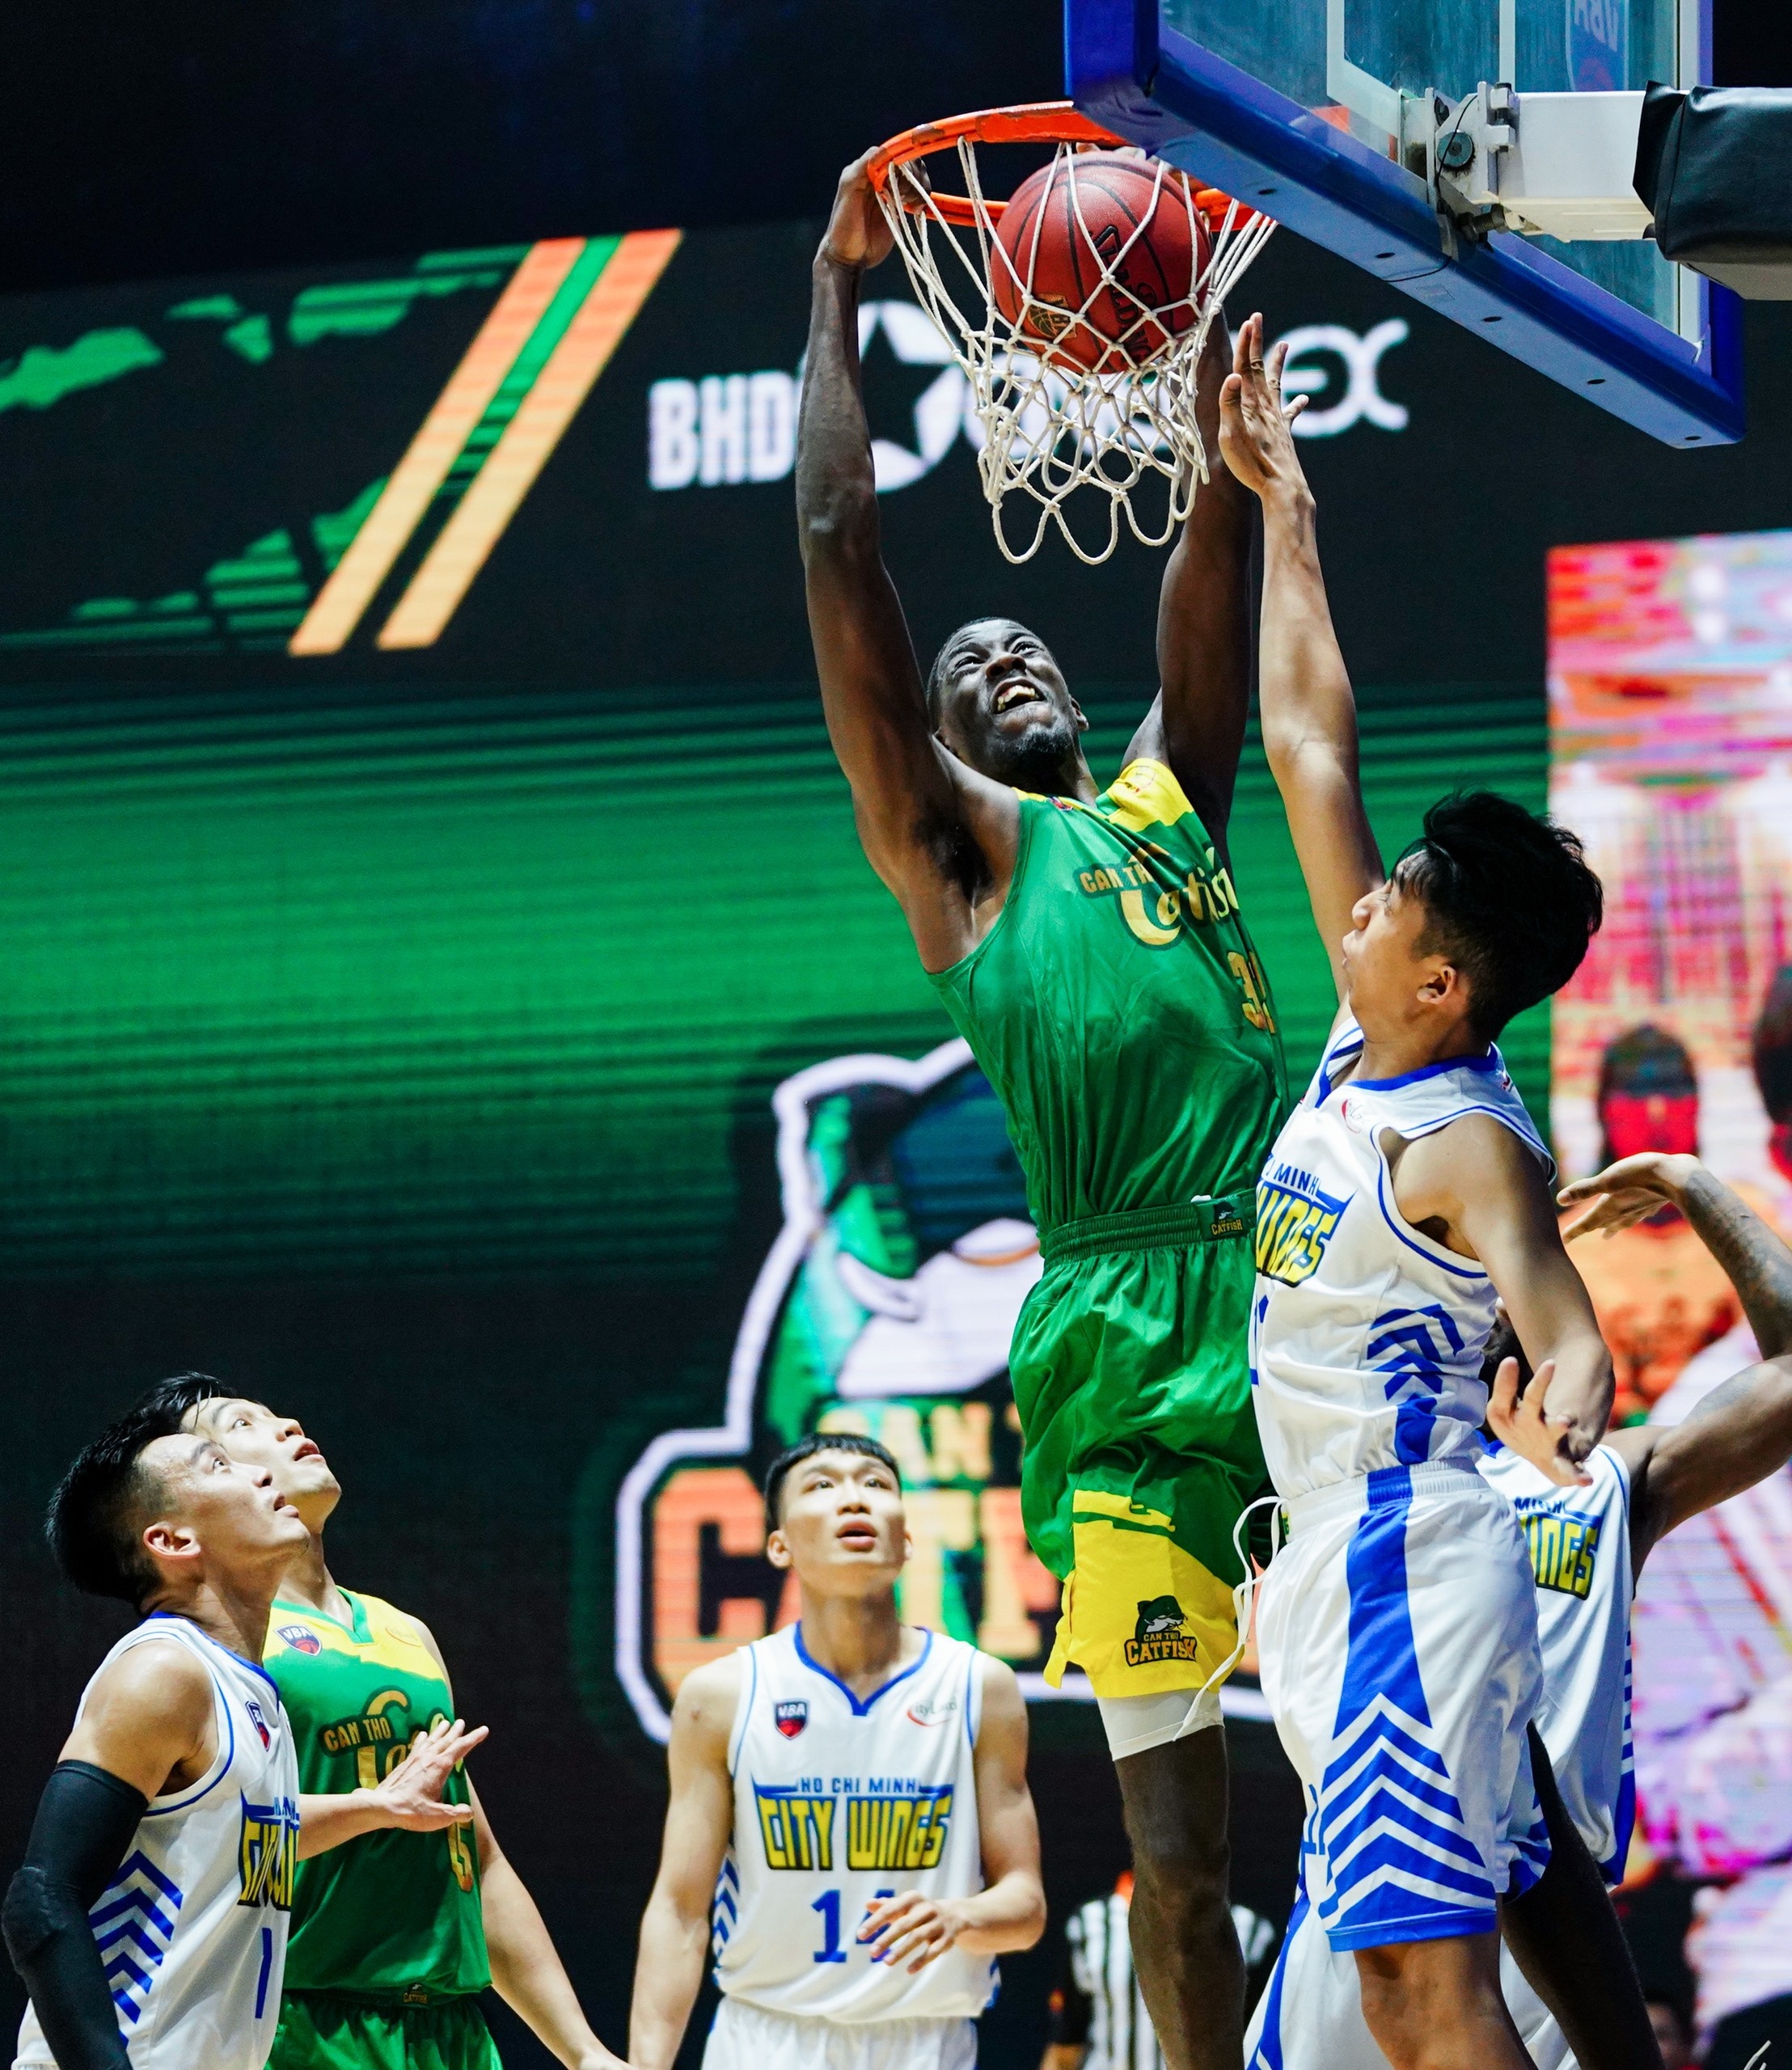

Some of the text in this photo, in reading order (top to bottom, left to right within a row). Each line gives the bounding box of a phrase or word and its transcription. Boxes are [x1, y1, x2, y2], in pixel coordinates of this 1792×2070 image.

[648, 370, 797, 490] BHD
[1079, 864, 1154, 893] CAN TH
[1211, 1219, 1243, 1236] CATFISH
[282, 1626, 312, 1640] VBA
[1143, 1633, 1162, 1641] CAN
[1126, 1637, 1195, 1665] CATFISH
[324, 1717, 391, 1752] CAN THO
[801, 1777, 917, 1793] HO CHI MINH
[757, 1794, 953, 1871] CITY WINGS
